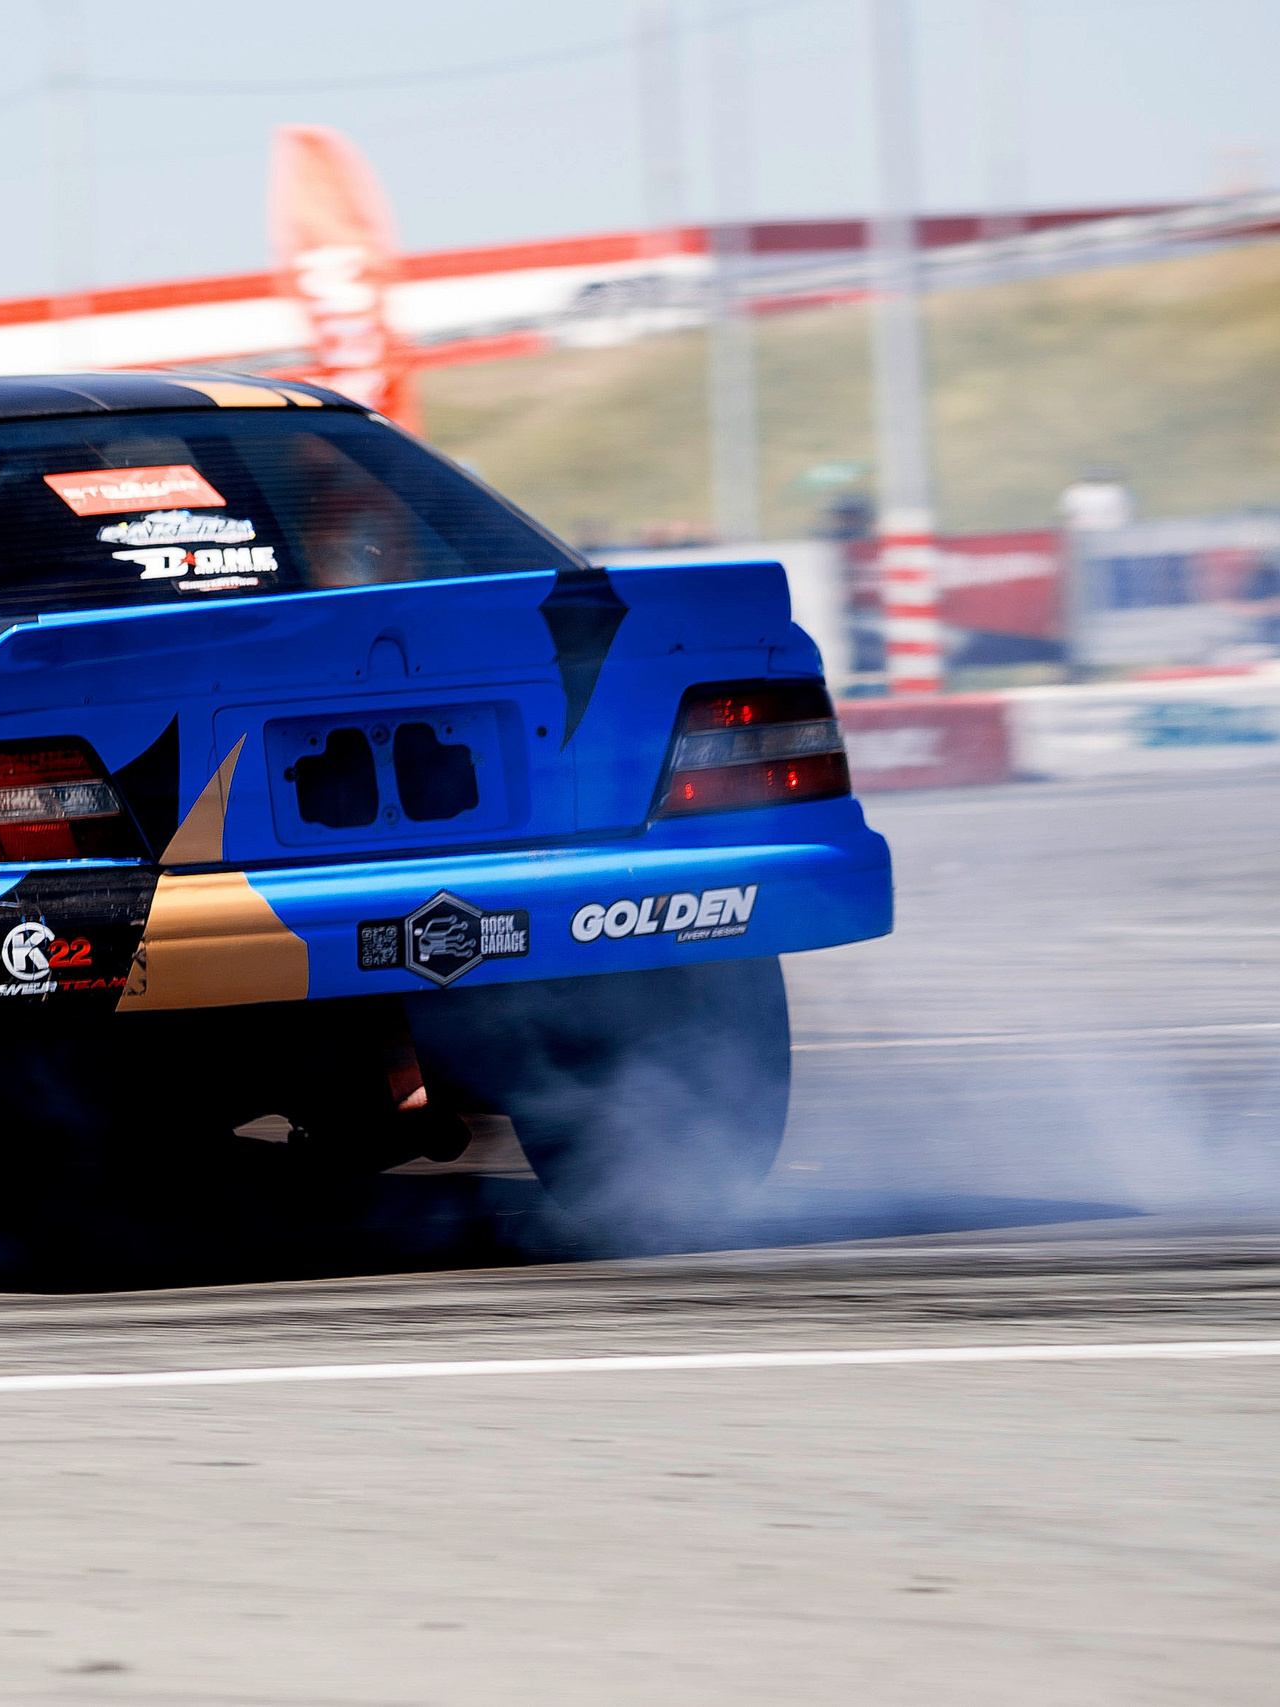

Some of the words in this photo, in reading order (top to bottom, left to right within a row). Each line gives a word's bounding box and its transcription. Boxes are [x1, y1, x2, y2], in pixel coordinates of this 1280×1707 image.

[480, 915, 515, 935] ROCK
[571, 885, 758, 942] GOLDEN
[480, 930, 527, 954] GARAGE
